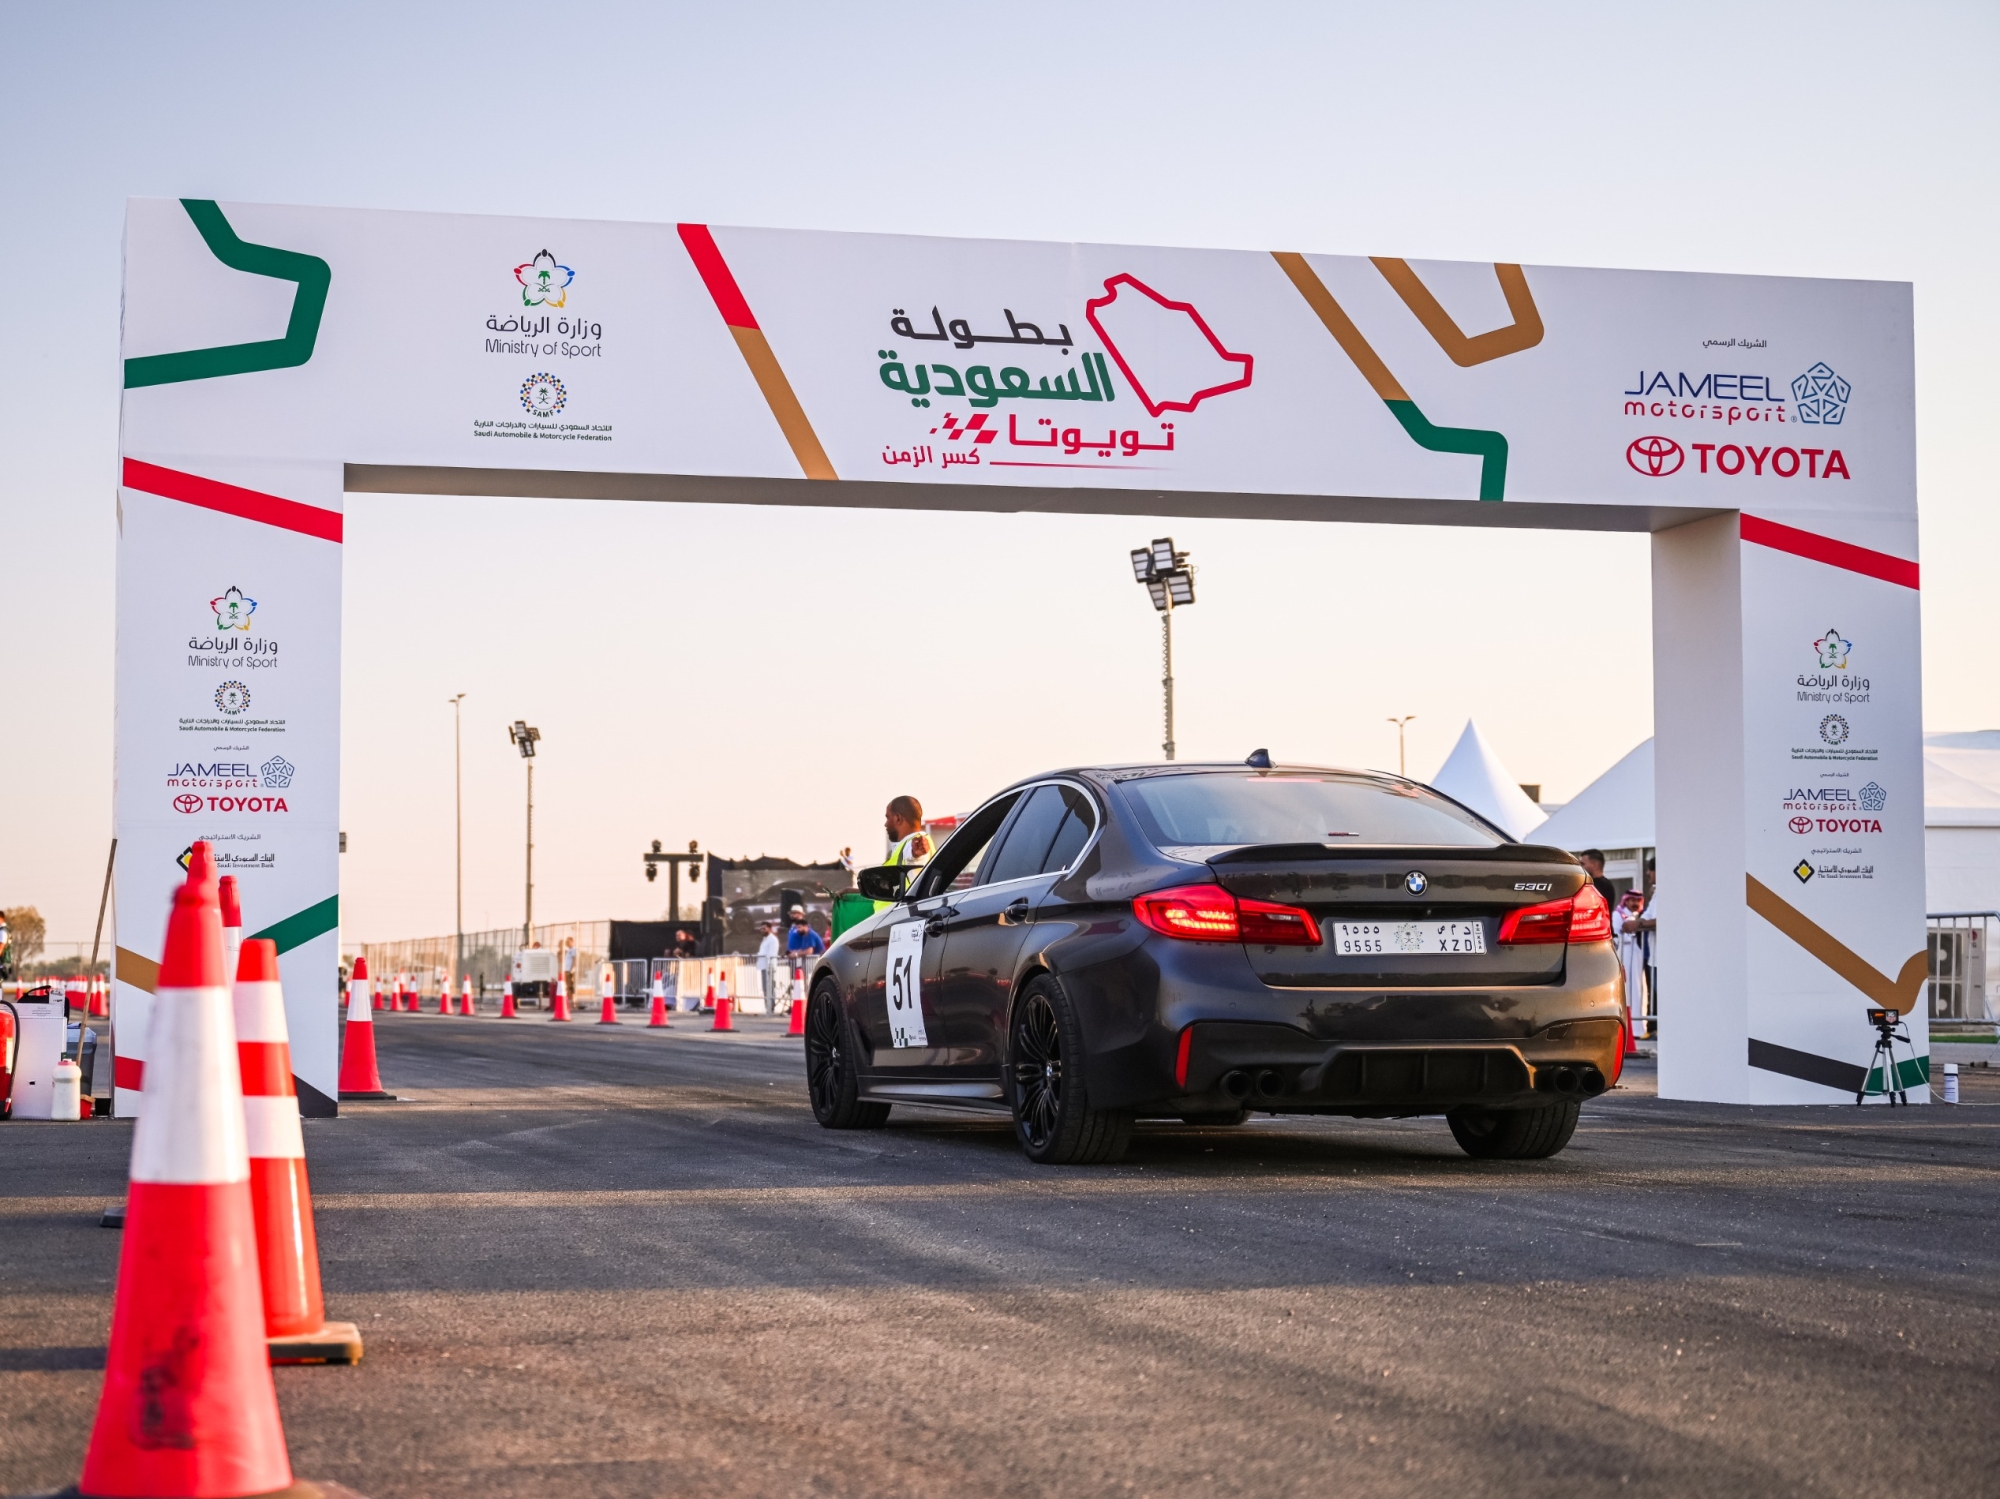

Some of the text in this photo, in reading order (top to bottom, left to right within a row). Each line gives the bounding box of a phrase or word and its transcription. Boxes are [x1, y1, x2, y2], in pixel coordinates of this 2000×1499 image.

[486, 314, 602, 340] وزارة الرياضة
[890, 305, 1073, 356] بطولة
[486, 338, 602, 359] Ministry of Sport
[1702, 338, 1767, 349] الشريك الرسمي
[877, 349, 1116, 408] السعودية
[1625, 370, 1785, 402] JAMEEL
[532, 409, 554, 418] SAMF
[1625, 400, 1785, 425] motorsport
[494, 431, 532, 439] Automobile
[540, 433, 576, 441] Motorcycle
[1009, 413, 1174, 457] تويوتا
[882, 445, 980, 468] كسر الزمن
[1692, 443, 1850, 479] TOYOTA
[189, 637, 277, 655] وزارة الرياضة
[188, 655, 277, 669] Ministry of Sport
[1797, 674, 1869, 691] وزارة الرياضة
[1797, 691, 1870, 704] Ministry of Sport
[167, 763, 257, 777] JAMEEL
[167, 778, 257, 790] motorsport
[1783, 788, 1857, 801] JAMEEL
[207, 797, 288, 812] TOYOTA
[1783, 802, 1857, 813] motorsport
[1816, 819, 1882, 833] TOYOTA
[1344, 940, 1382, 953] 9555
[893, 955, 912, 1011] 51
